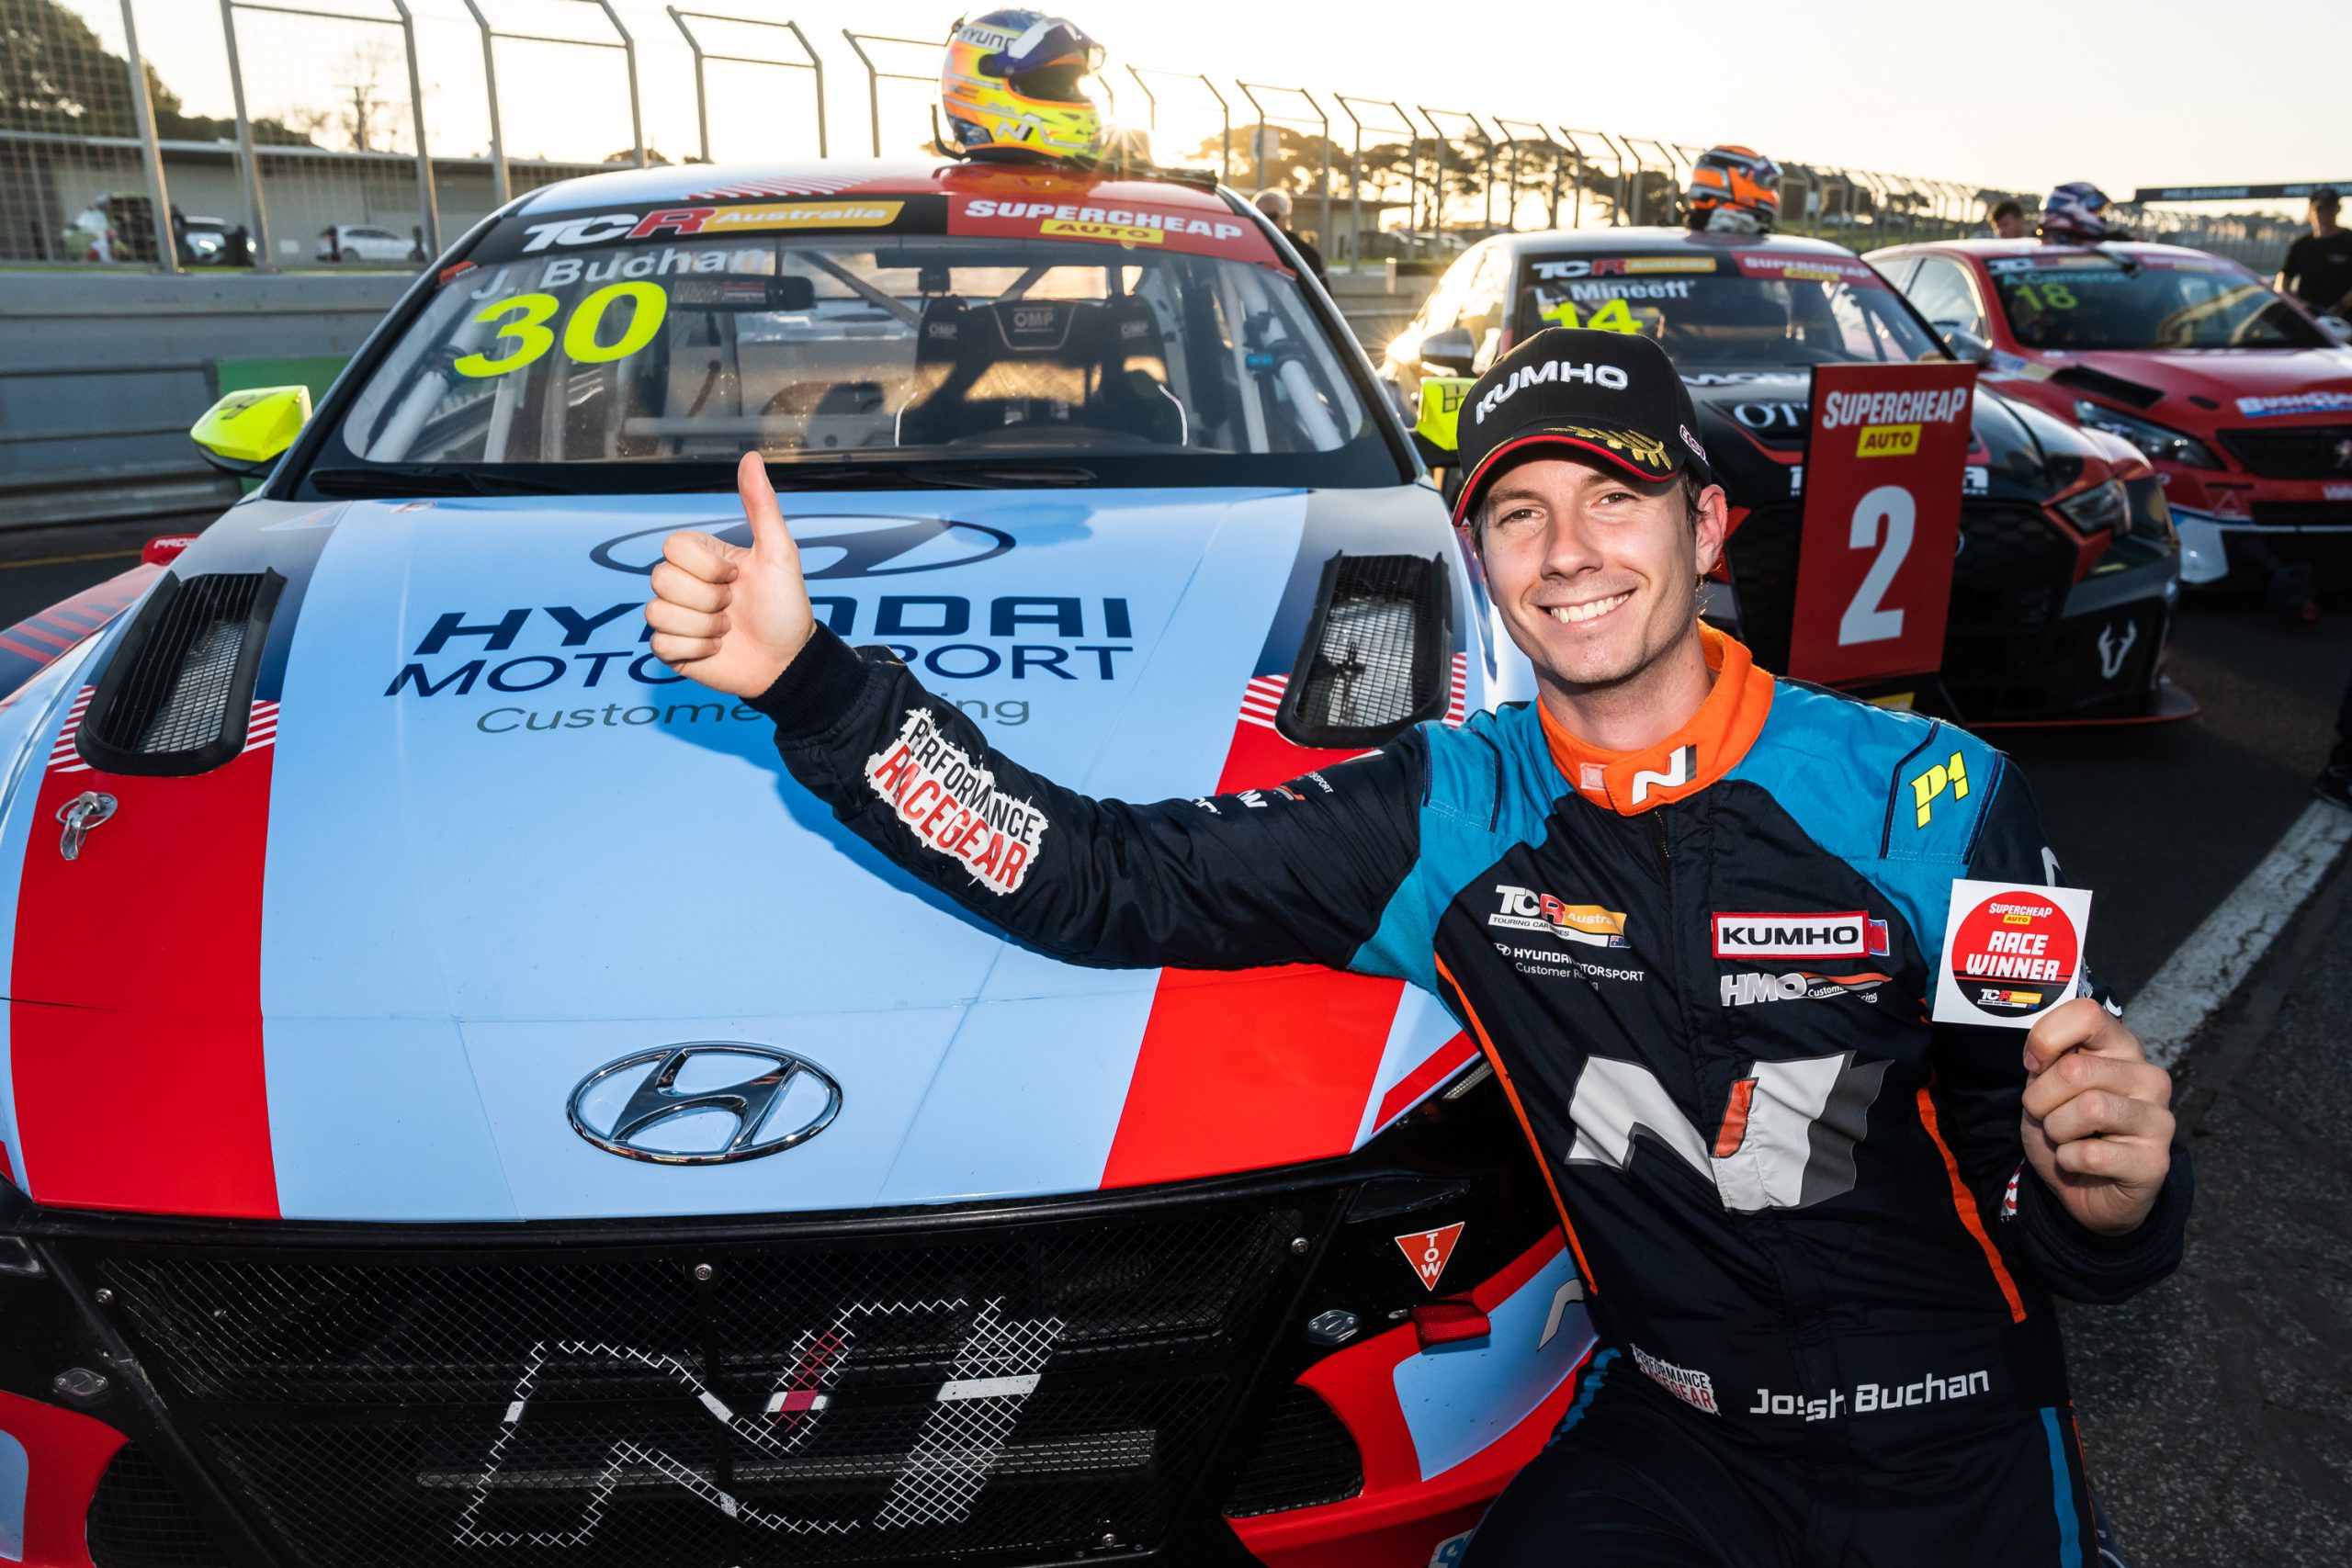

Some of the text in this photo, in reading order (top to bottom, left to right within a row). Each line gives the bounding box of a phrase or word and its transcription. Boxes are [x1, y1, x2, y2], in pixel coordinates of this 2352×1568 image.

[523, 205, 888, 253] TCR Australia
[965, 200, 1243, 240] SUPERCHEAP
[1054, 222, 1150, 239] AUTO
[471, 248, 765, 299] J. Buchan
[1532, 257, 1627, 279] TCR
[2015, 282, 2078, 311] 18
[454, 281, 668, 378] 30
[1014, 312, 1055, 327] OMP
[1541, 299, 1644, 335] 14
[1476, 360, 1629, 425] KUMHO
[1822, 388, 1967, 429] SUPERCHEAP
[1864, 431, 1914, 450] AUTO
[1838, 485, 1917, 647] 2
[413, 595, 1133, 655] HYNDAI
[383, 643, 1133, 697] MOTOORT
[477, 702, 763, 734] Custome
[907, 717, 1041, 846] PRFORMNCE
[1908, 750, 1970, 831] P1
[1495, 884, 1566, 925] TCR
[1989, 903, 2053, 918] SUPERCHEAP
[1493, 917, 1532, 927] TOURING
[1532, 921, 1549, 930] CAR
[1723, 926, 1859, 945] KUMHO
[1987, 931, 2050, 955] RACE
[1514, 947, 1572, 964] HYUNDAI
[1572, 957, 1645, 982] TORSPORT
[1516, 963, 1571, 978] Customer
[1965, 953, 2061, 981] WINNER
[1720, 973, 1807, 1007] HMO
[1807, 985, 1845, 998] Custom
[1981, 988, 2012, 1002] TCR
[1421, 1233, 1442, 1278] TOW
[1854, 1370, 1990, 1413] Buchan
